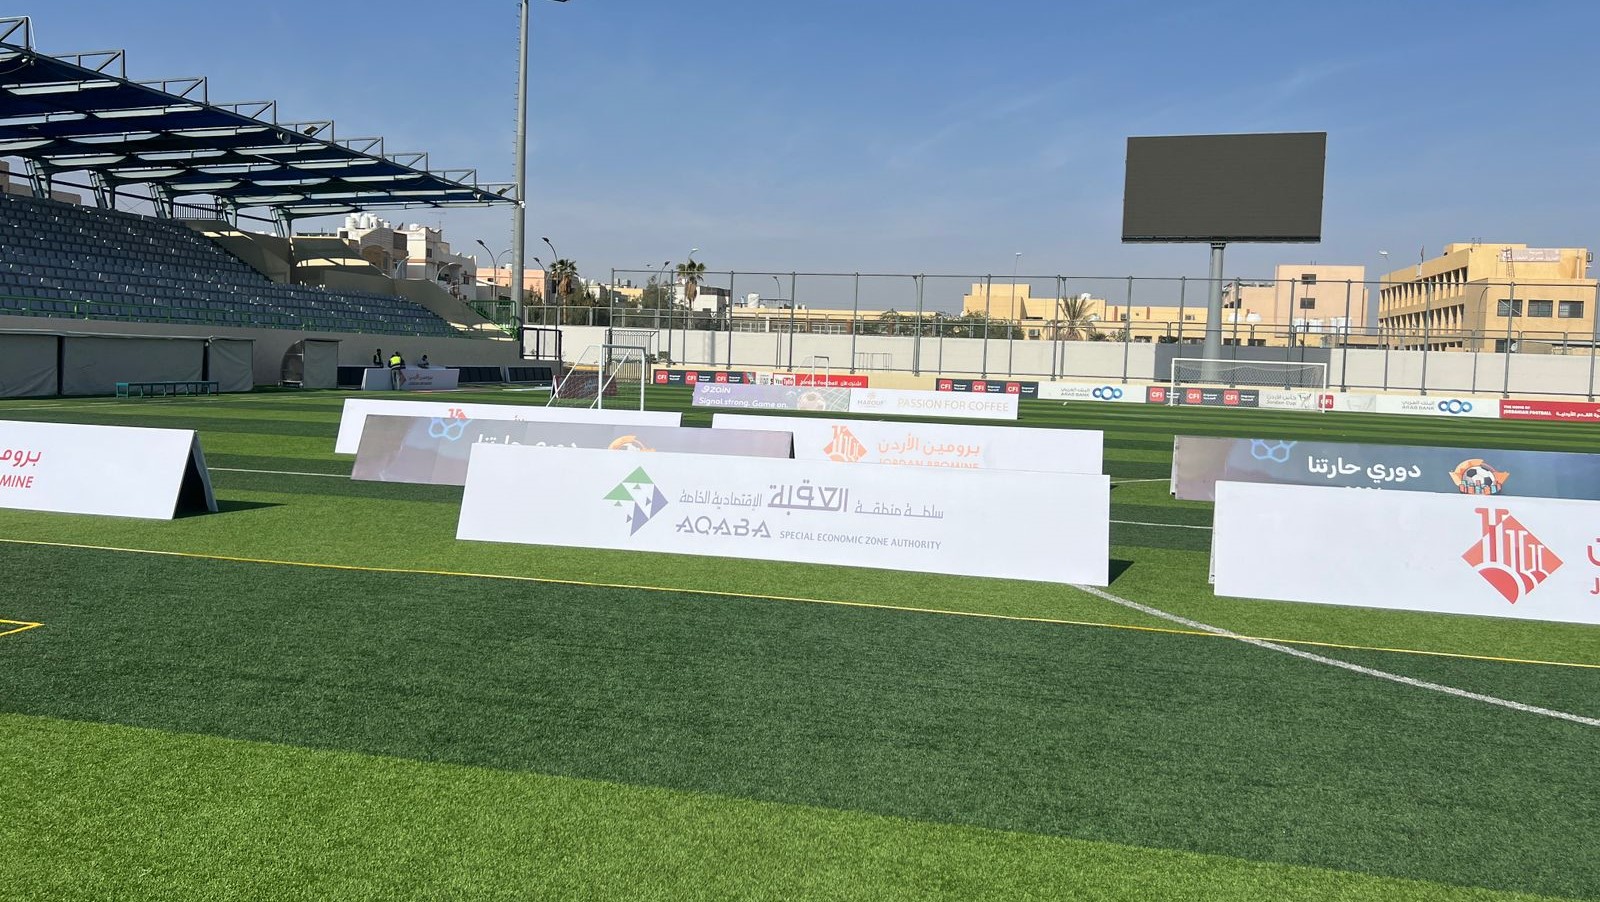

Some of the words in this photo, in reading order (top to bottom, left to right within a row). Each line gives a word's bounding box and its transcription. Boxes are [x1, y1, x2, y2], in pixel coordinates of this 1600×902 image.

[698, 397, 723, 406] Signal
[724, 398, 750, 408] strong.
[896, 398, 942, 409] PASSION
[944, 400, 966, 410] FOR
[968, 400, 1010, 412] COFFEE
[1308, 456, 1361, 479] حارتنا
[1366, 464, 1422, 484] دوري
[676, 515, 772, 538] AQABA
[780, 530, 815, 541] SPECIAL
[817, 532, 864, 545] ECONOMIC
[865, 535, 889, 547] ZONE
[890, 538, 942, 550] AUTHORITY
